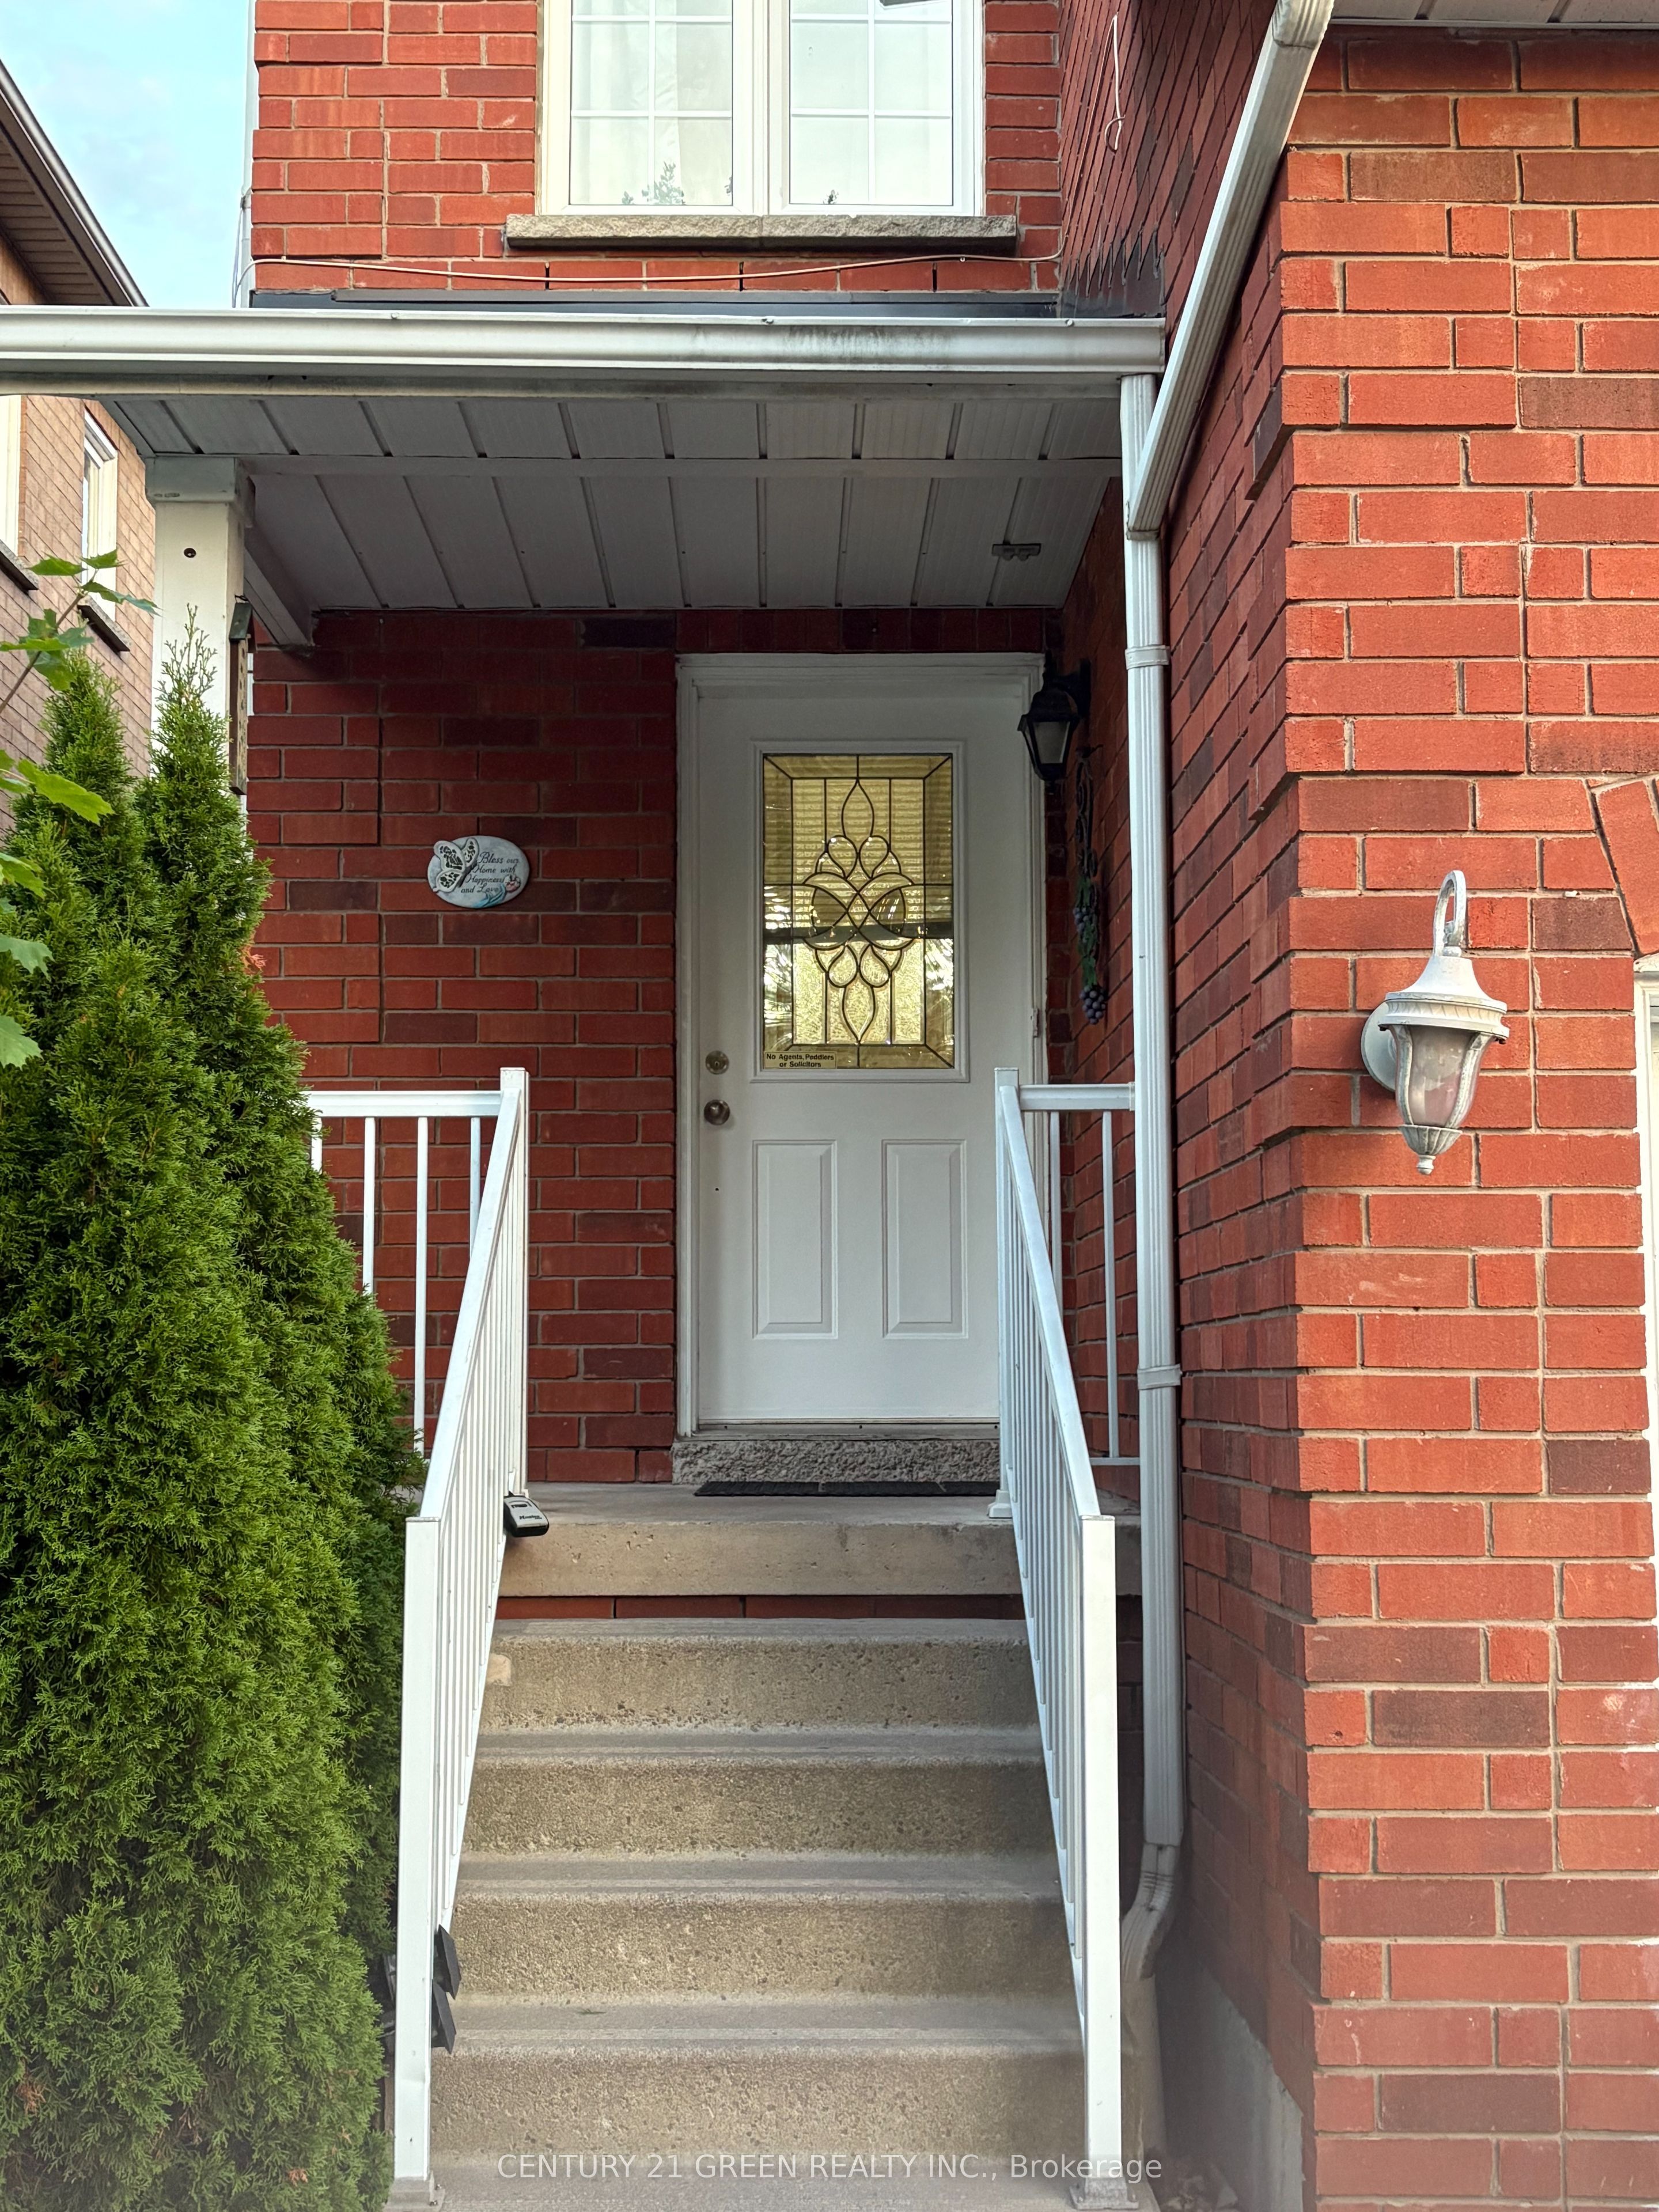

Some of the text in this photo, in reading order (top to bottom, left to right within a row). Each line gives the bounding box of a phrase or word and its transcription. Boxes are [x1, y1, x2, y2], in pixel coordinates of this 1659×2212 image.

[478, 851, 503, 863] Bless
[473, 864, 517, 873] Home with
[477, 883, 499, 893] Love
